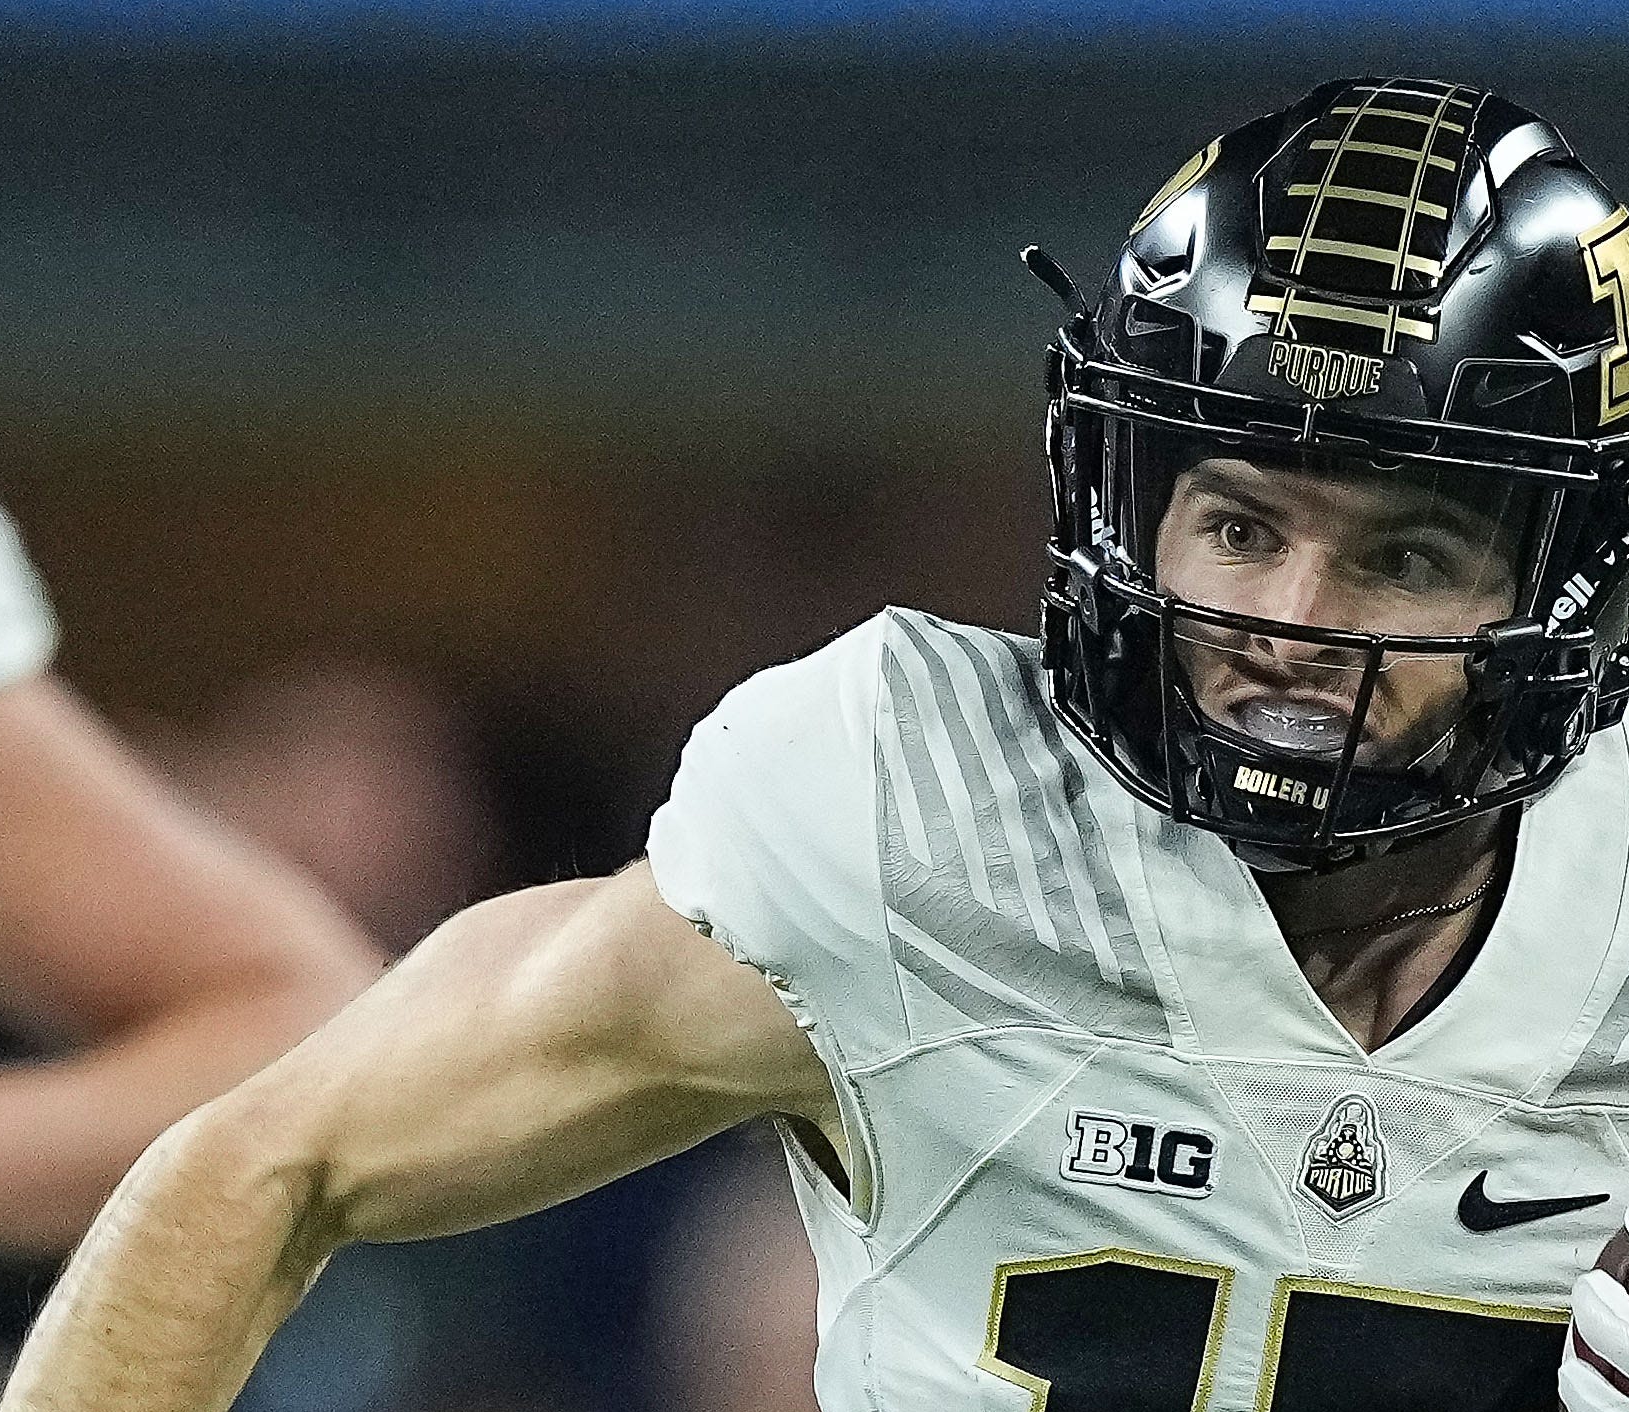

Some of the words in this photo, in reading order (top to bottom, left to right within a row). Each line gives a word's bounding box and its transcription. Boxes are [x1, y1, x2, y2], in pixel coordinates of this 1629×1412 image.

[1267, 341, 1385, 399] PURDUE
[1233, 765, 1308, 805] BOILER
[1309, 1163, 1373, 1200] PURDUE
